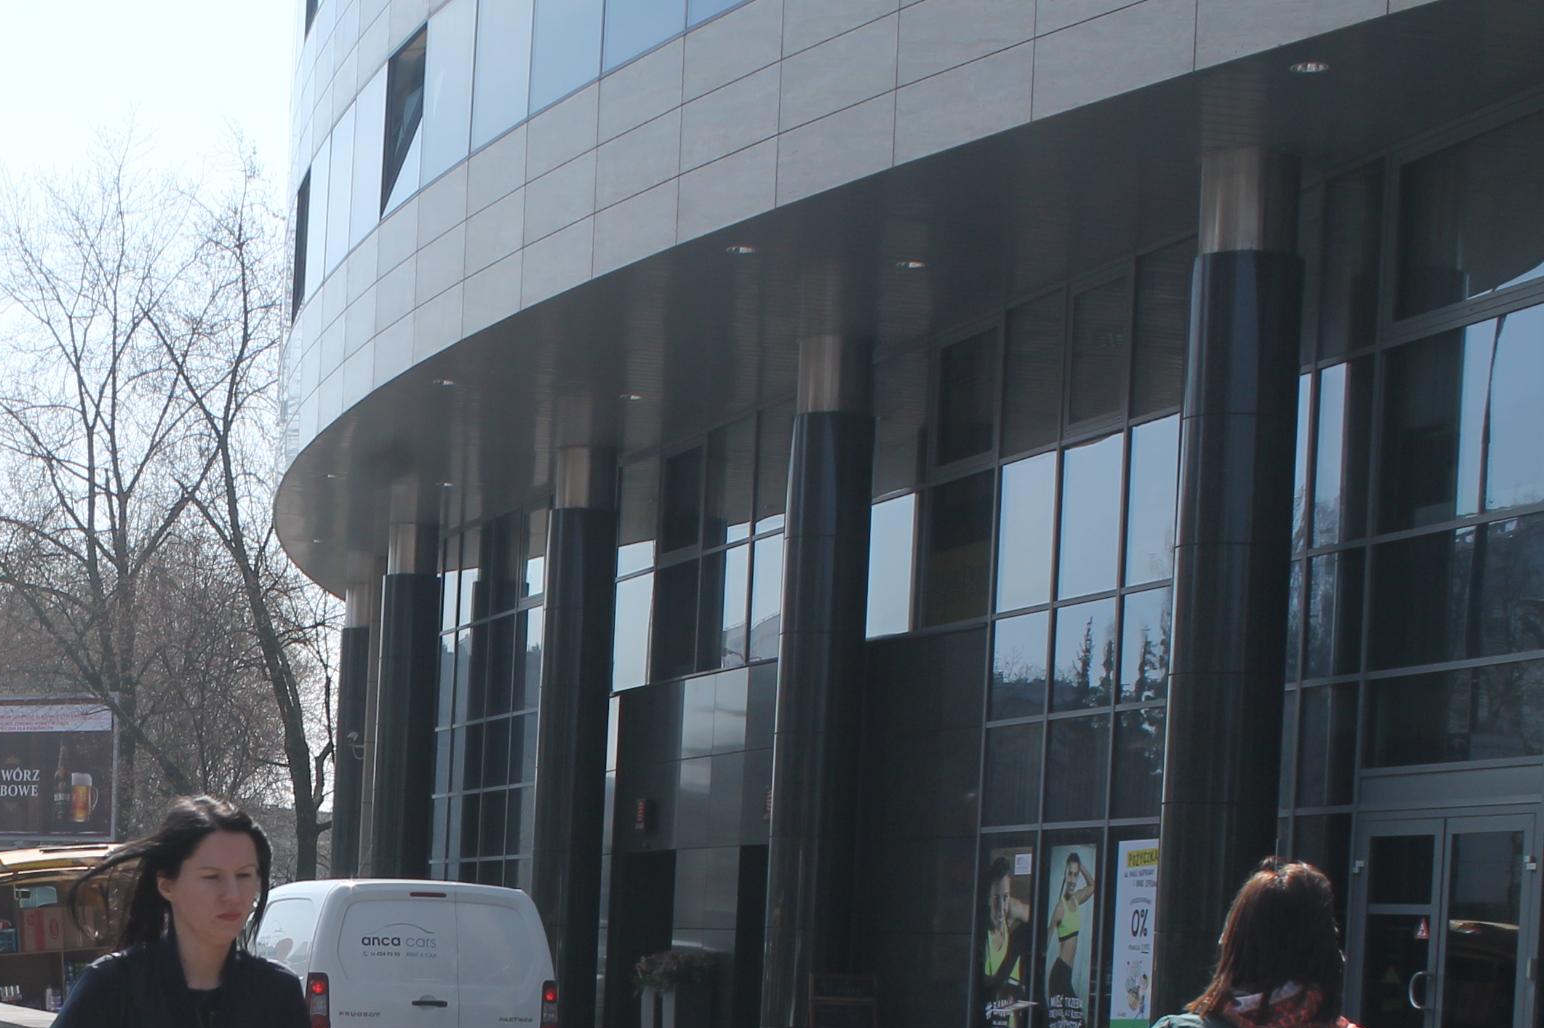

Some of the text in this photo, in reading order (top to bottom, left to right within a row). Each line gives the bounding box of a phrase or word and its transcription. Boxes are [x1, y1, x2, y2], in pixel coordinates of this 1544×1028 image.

[1131, 909, 1148, 937] 0%
[361, 936, 436, 948] anca cars
